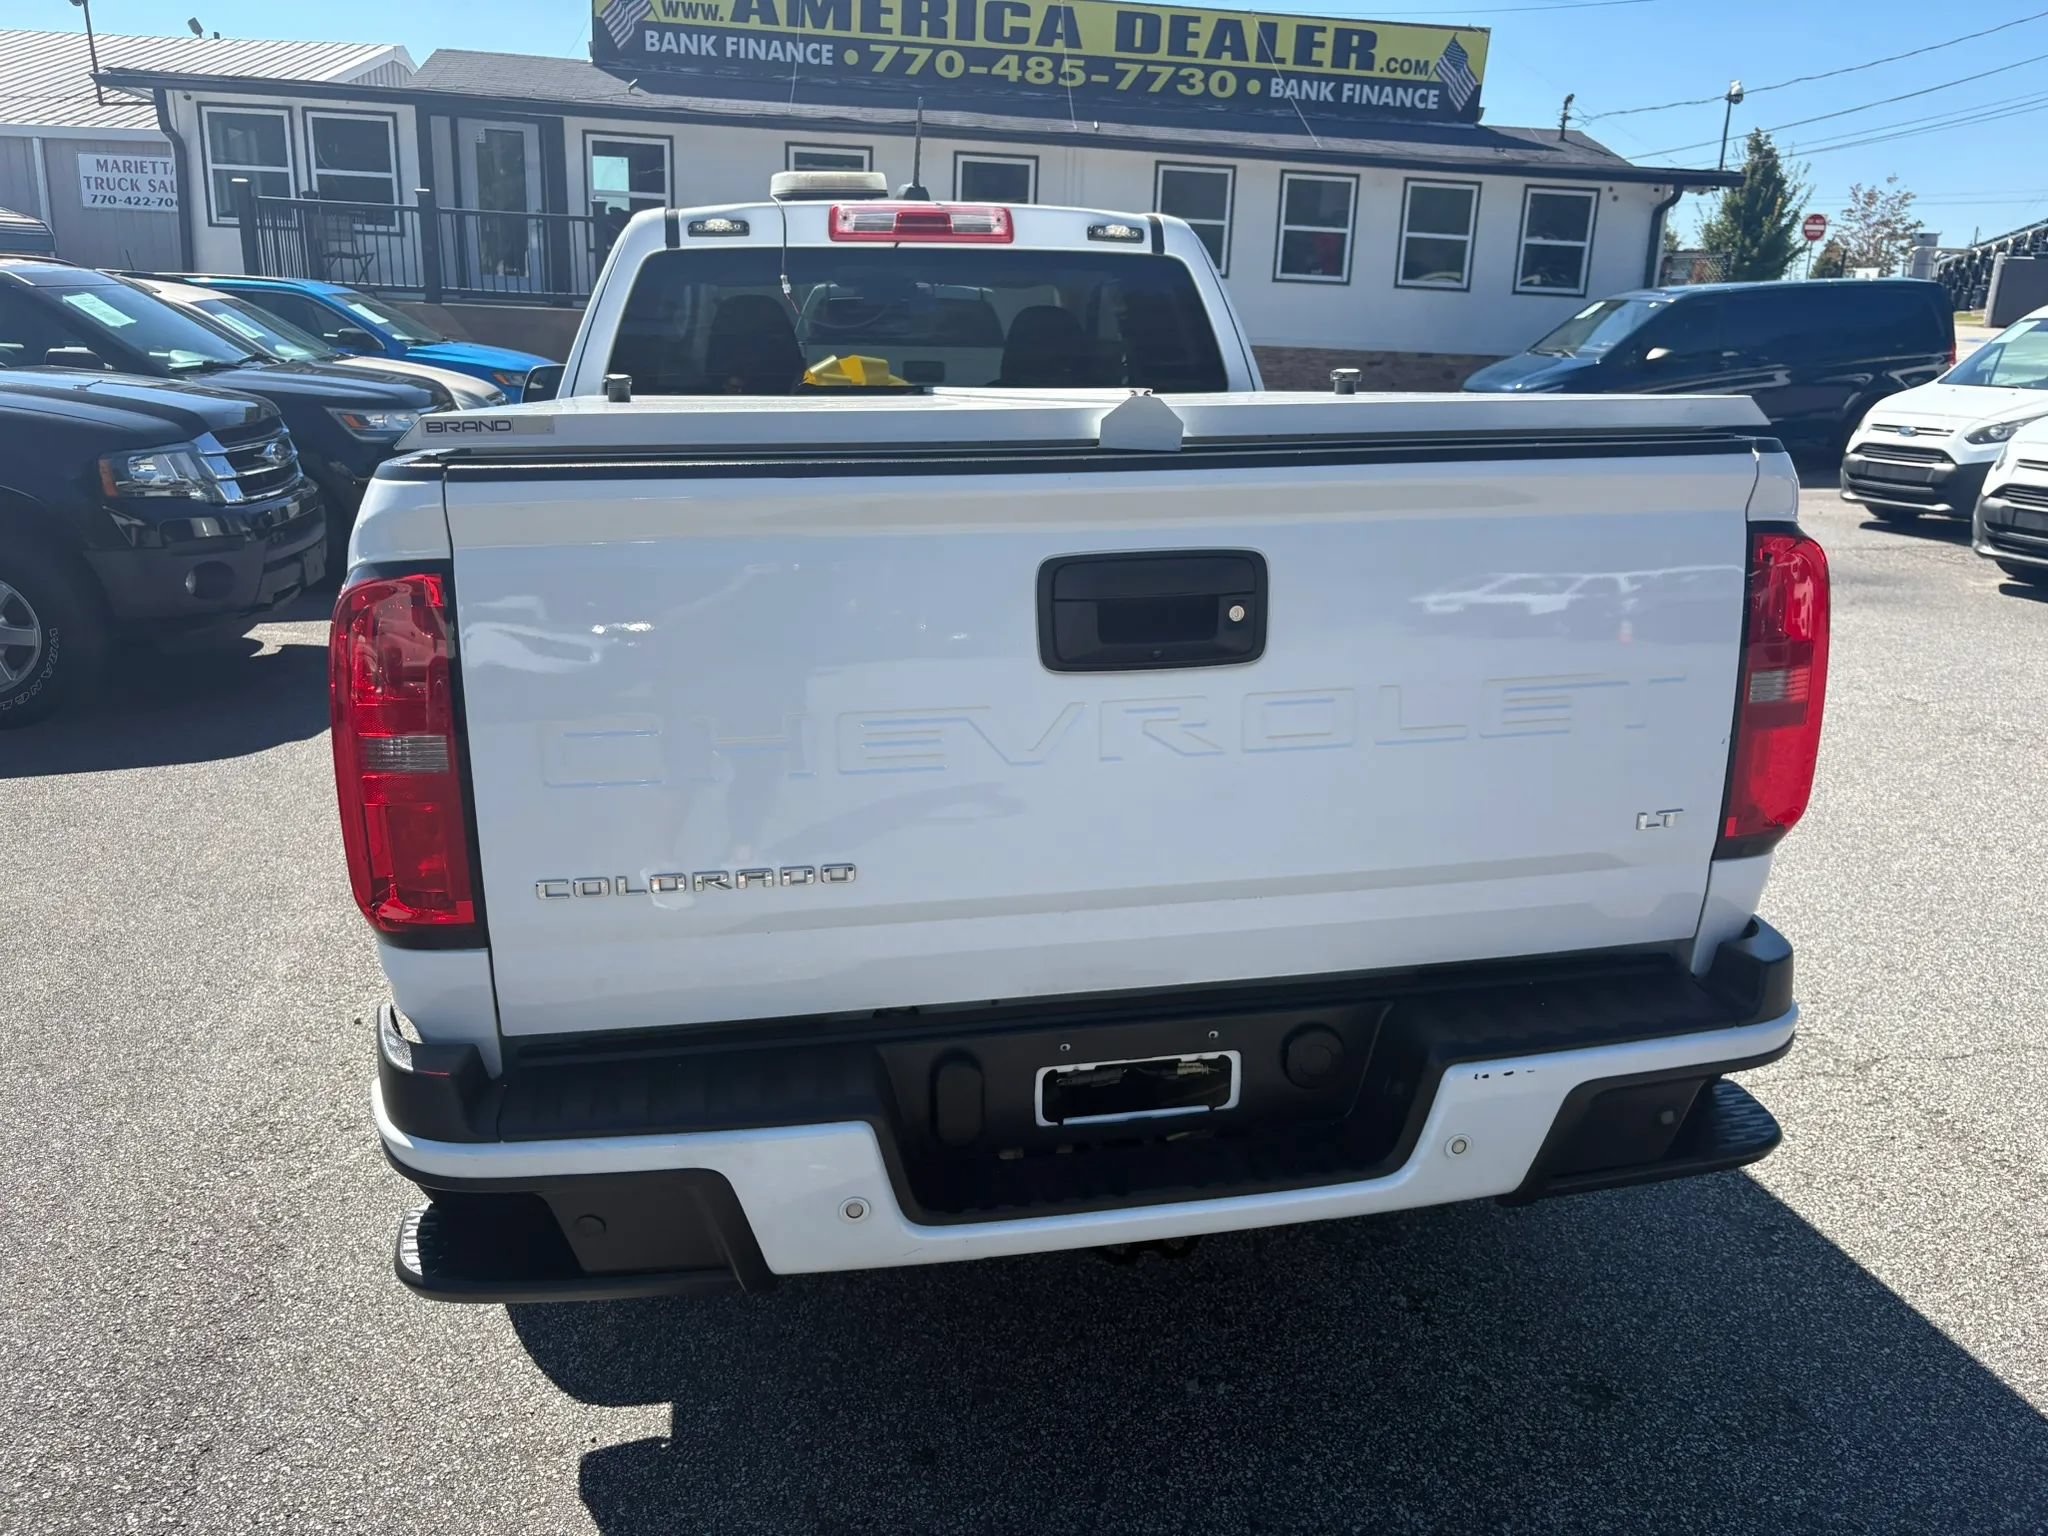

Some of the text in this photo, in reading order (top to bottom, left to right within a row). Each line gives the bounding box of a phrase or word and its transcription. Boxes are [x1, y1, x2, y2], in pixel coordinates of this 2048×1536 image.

[645, 30, 1440, 110] BANK FINANCE 770-485-7730 BANK FINANCE
[83, 175, 140, 192] TRUCK
[91, 193, 178, 207] 770-422-70
[425, 420, 512, 433] BRAND
[540, 672, 1688, 789] CHEVROLET
[1636, 808, 1684, 831] LT
[535, 862, 857, 900] COLORADO
